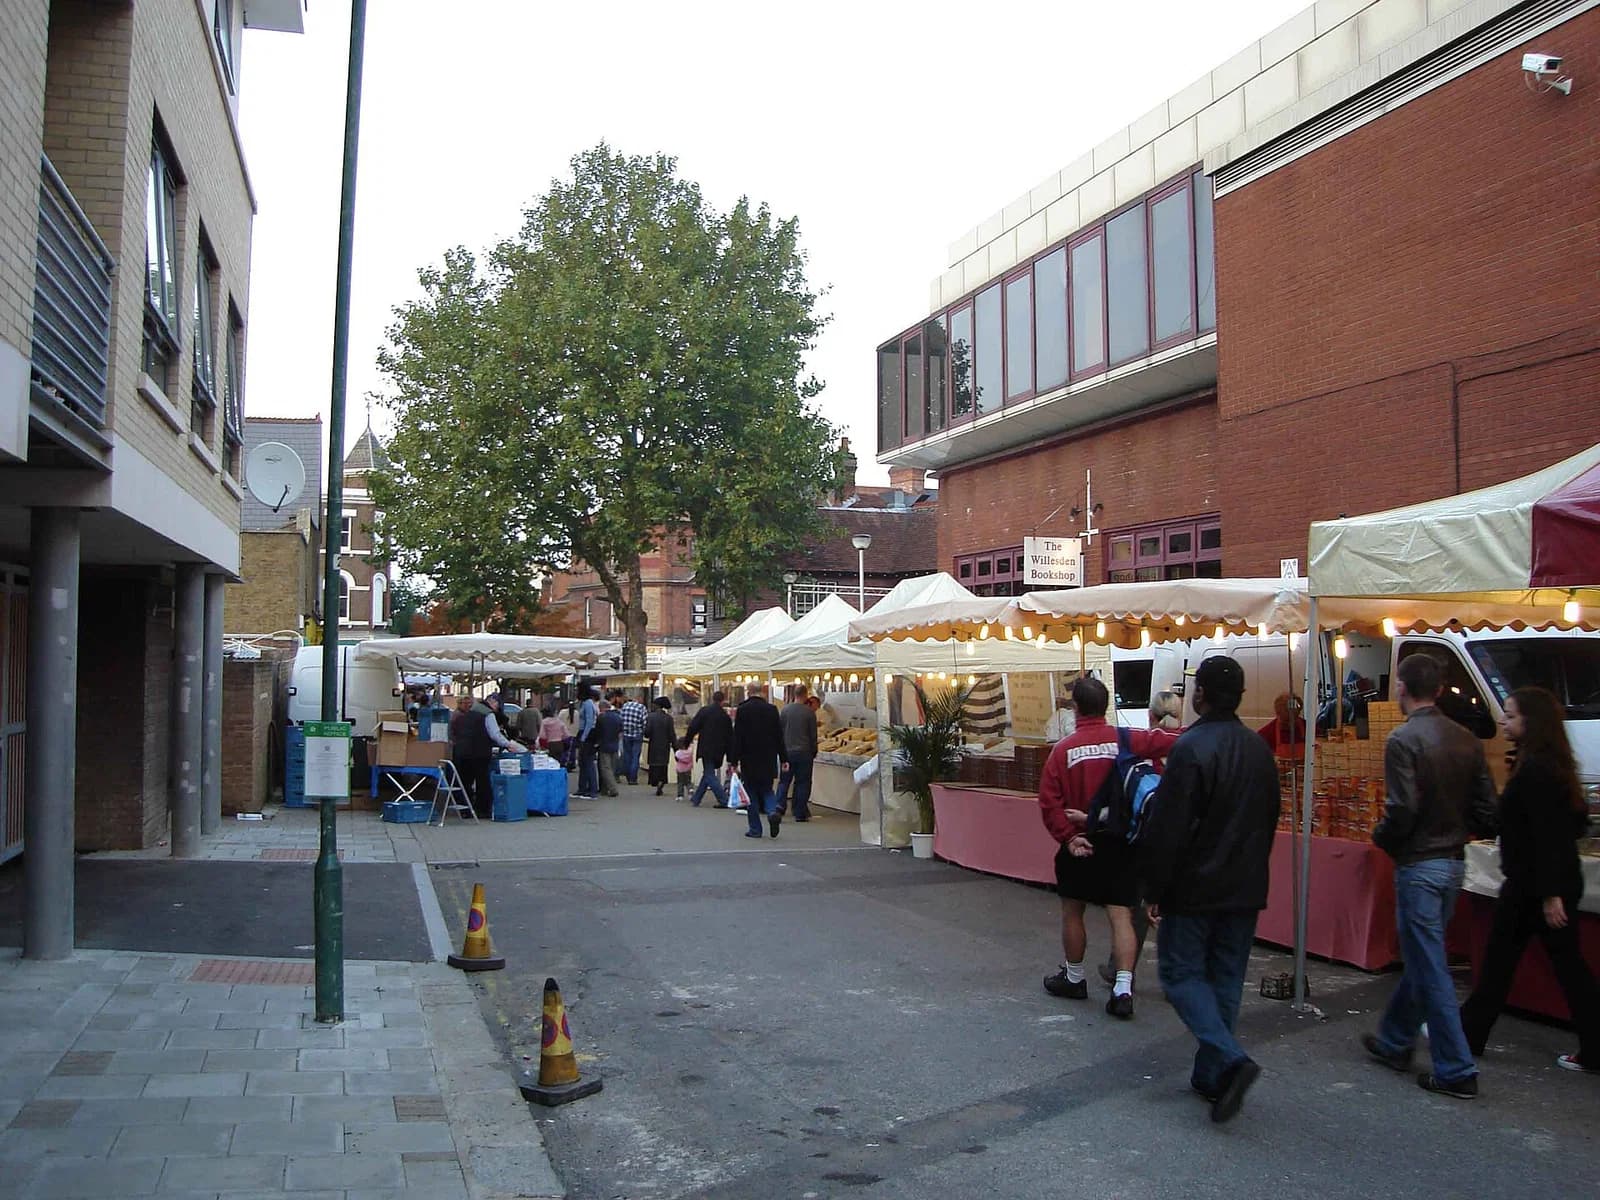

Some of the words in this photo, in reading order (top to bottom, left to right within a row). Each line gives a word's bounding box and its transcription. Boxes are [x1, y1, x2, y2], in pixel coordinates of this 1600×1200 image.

[1044, 541, 1062, 551] The
[1031, 555, 1076, 566] Willesden
[1031, 569, 1076, 581] Bookshop
